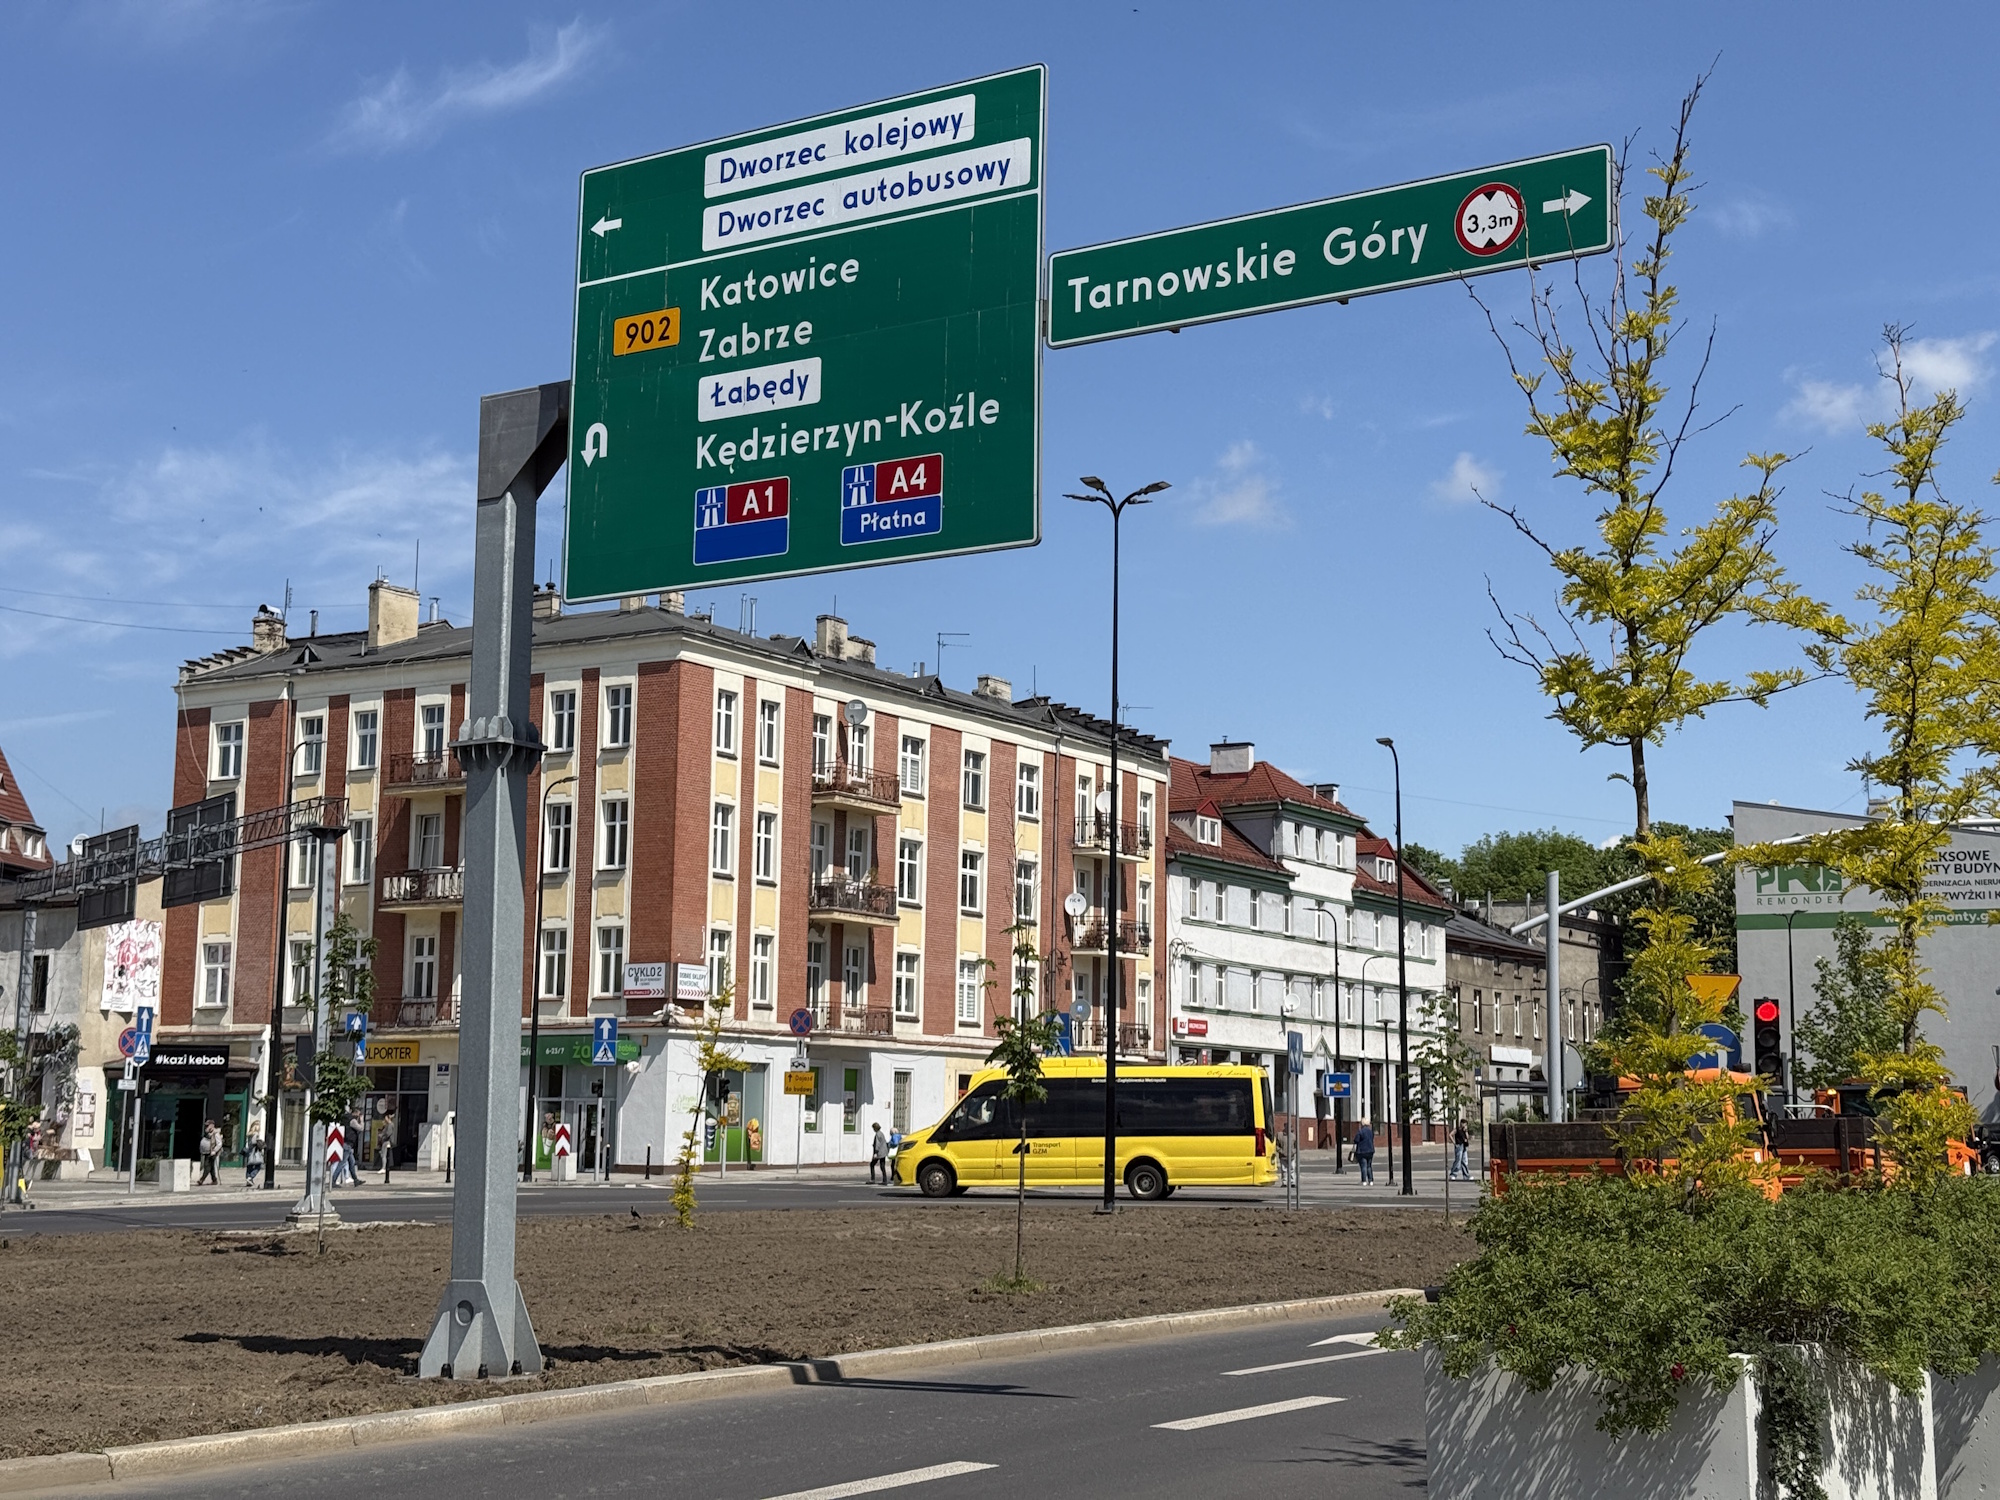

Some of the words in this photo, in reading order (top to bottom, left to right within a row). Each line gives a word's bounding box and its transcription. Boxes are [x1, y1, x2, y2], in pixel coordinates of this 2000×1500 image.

[719, 143, 827, 184] Dworzec
[844, 112, 964, 155] kolejowy
[718, 197, 825, 237] Dworzec
[843, 157, 1011, 210] autobusowy
[1467, 214, 1513, 233] 3,3m
[1067, 242, 1296, 313] Tarnowskie
[1323, 220, 1428, 265] Góry
[701, 256, 859, 311] Katowice
[625, 316, 671, 349] 902
[699, 321, 813, 363] Zabrze
[711, 369, 810, 405] Łabędy
[696, 391, 1000, 474] Kędzierzyn-Koźle
[890, 463, 928, 495] A4
[742, 486, 774, 517] A1
[860, 511, 926, 533] Płatna
[1924, 850, 1991, 862] KSOWE
[1922, 879, 1972, 887] DERNIZACJA
[657, 967, 662, 977] 2
[155, 1054, 187, 1065] #kazi
[188, 1055, 225, 1065] kebab
